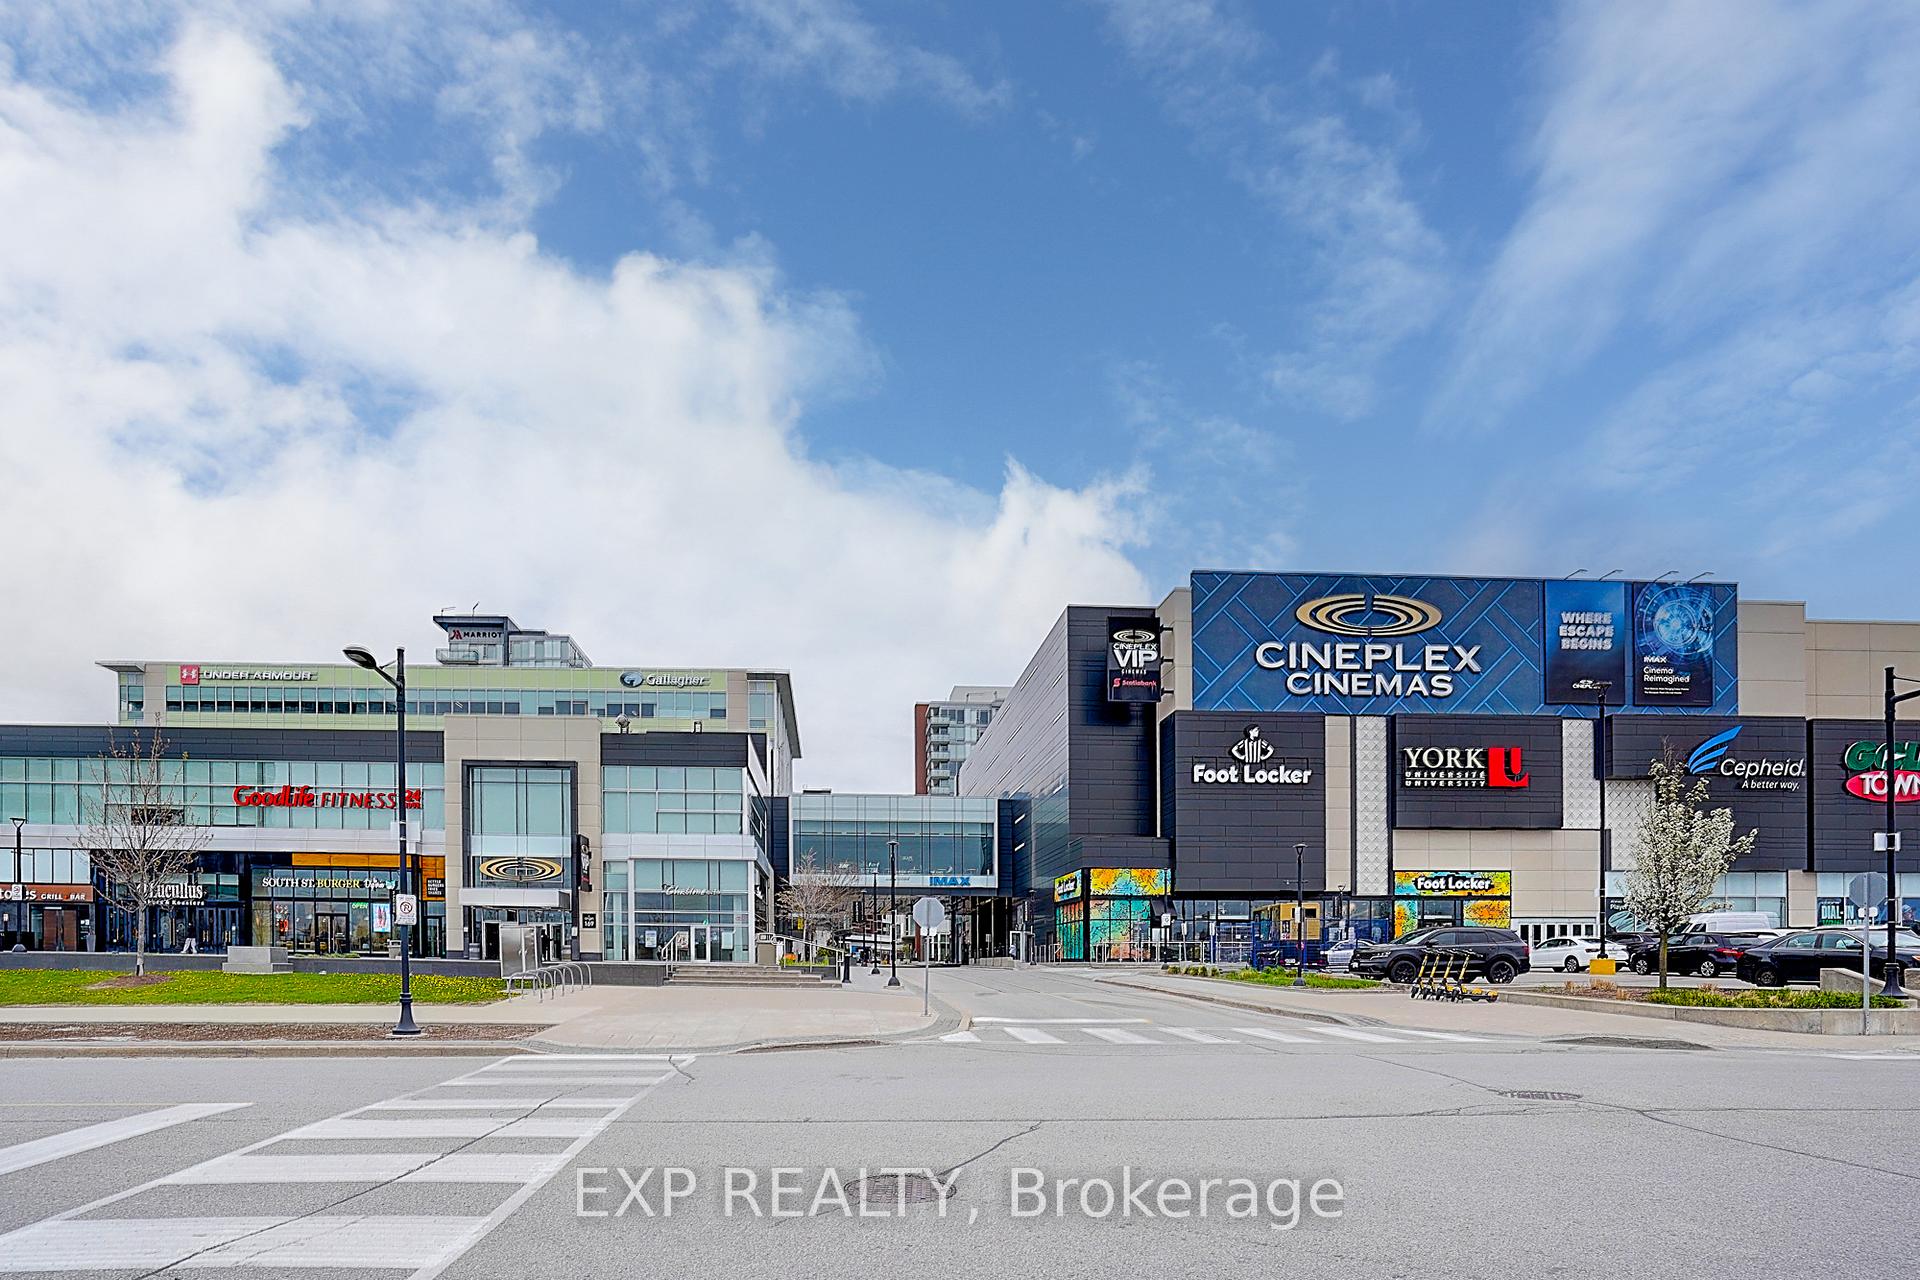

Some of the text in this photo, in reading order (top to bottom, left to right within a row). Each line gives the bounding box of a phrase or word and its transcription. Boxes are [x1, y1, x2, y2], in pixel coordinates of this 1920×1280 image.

[1561, 611, 1612, 624] WHERE
[463, 631, 505, 639] MARRIOT
[1559, 625, 1614, 637] ESCAPE
[1113, 642, 1157, 650] CINEPLEX
[1561, 637, 1612, 650] BEGINS
[1113, 650, 1158, 668] VIP
[1255, 641, 1482, 673] CINEPLEX
[203, 670, 312, 681] UNDER ARMOUR
[1643, 666, 1673, 674] Cinema
[647, 674, 704, 688] Gallagher
[1122, 680, 1157, 688] Scotiabank
[1287, 672, 1454, 697] CINEMAS
[1643, 675, 1690, 685] Reimagined
[1403, 747, 1486, 769] YORK
[1193, 764, 1312, 784] Foot Locker
[1404, 780, 1486, 788] UNIVERSITY
[1741, 780, 1800, 791] A better way.
[232, 785, 397, 809] GoodLife FITNESS
[405, 789, 420, 801] 24
[262, 878, 299, 888] SOUTH
[301, 879, 316, 888] ST.
[317, 879, 360, 888] BURGER
[929, 877, 971, 887] IMAX
[1417, 877, 1491, 890] Foot Locker
